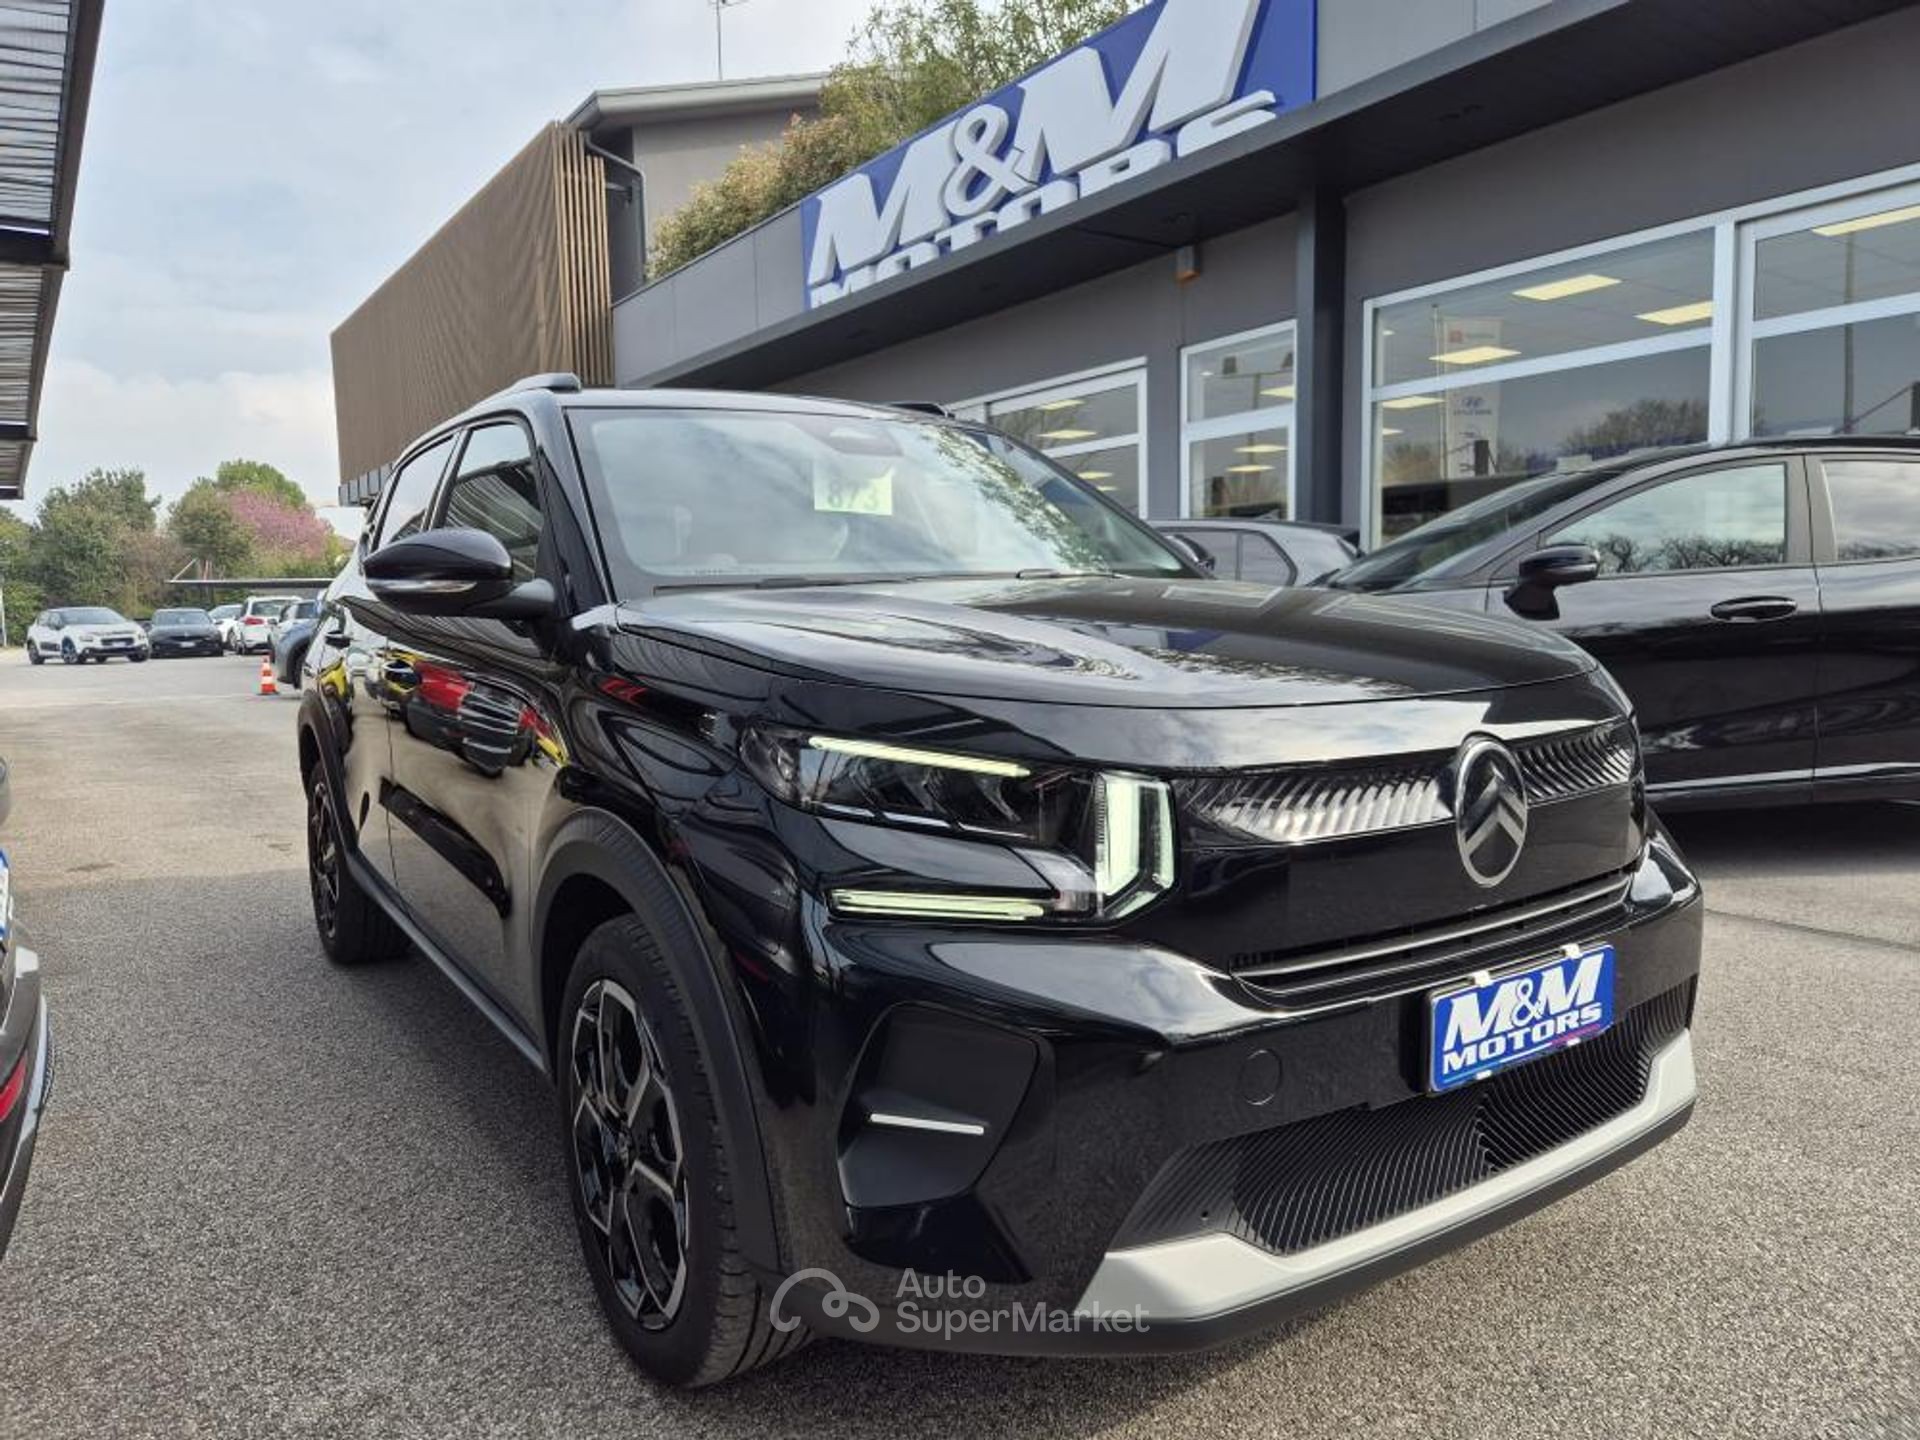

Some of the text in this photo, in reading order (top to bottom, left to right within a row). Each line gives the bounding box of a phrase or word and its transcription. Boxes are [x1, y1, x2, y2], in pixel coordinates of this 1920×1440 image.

[807, 0, 1258, 284] M&M
[1442, 1002, 1603, 1074] MOTORS
[1443, 952, 1604, 1051] M&M
